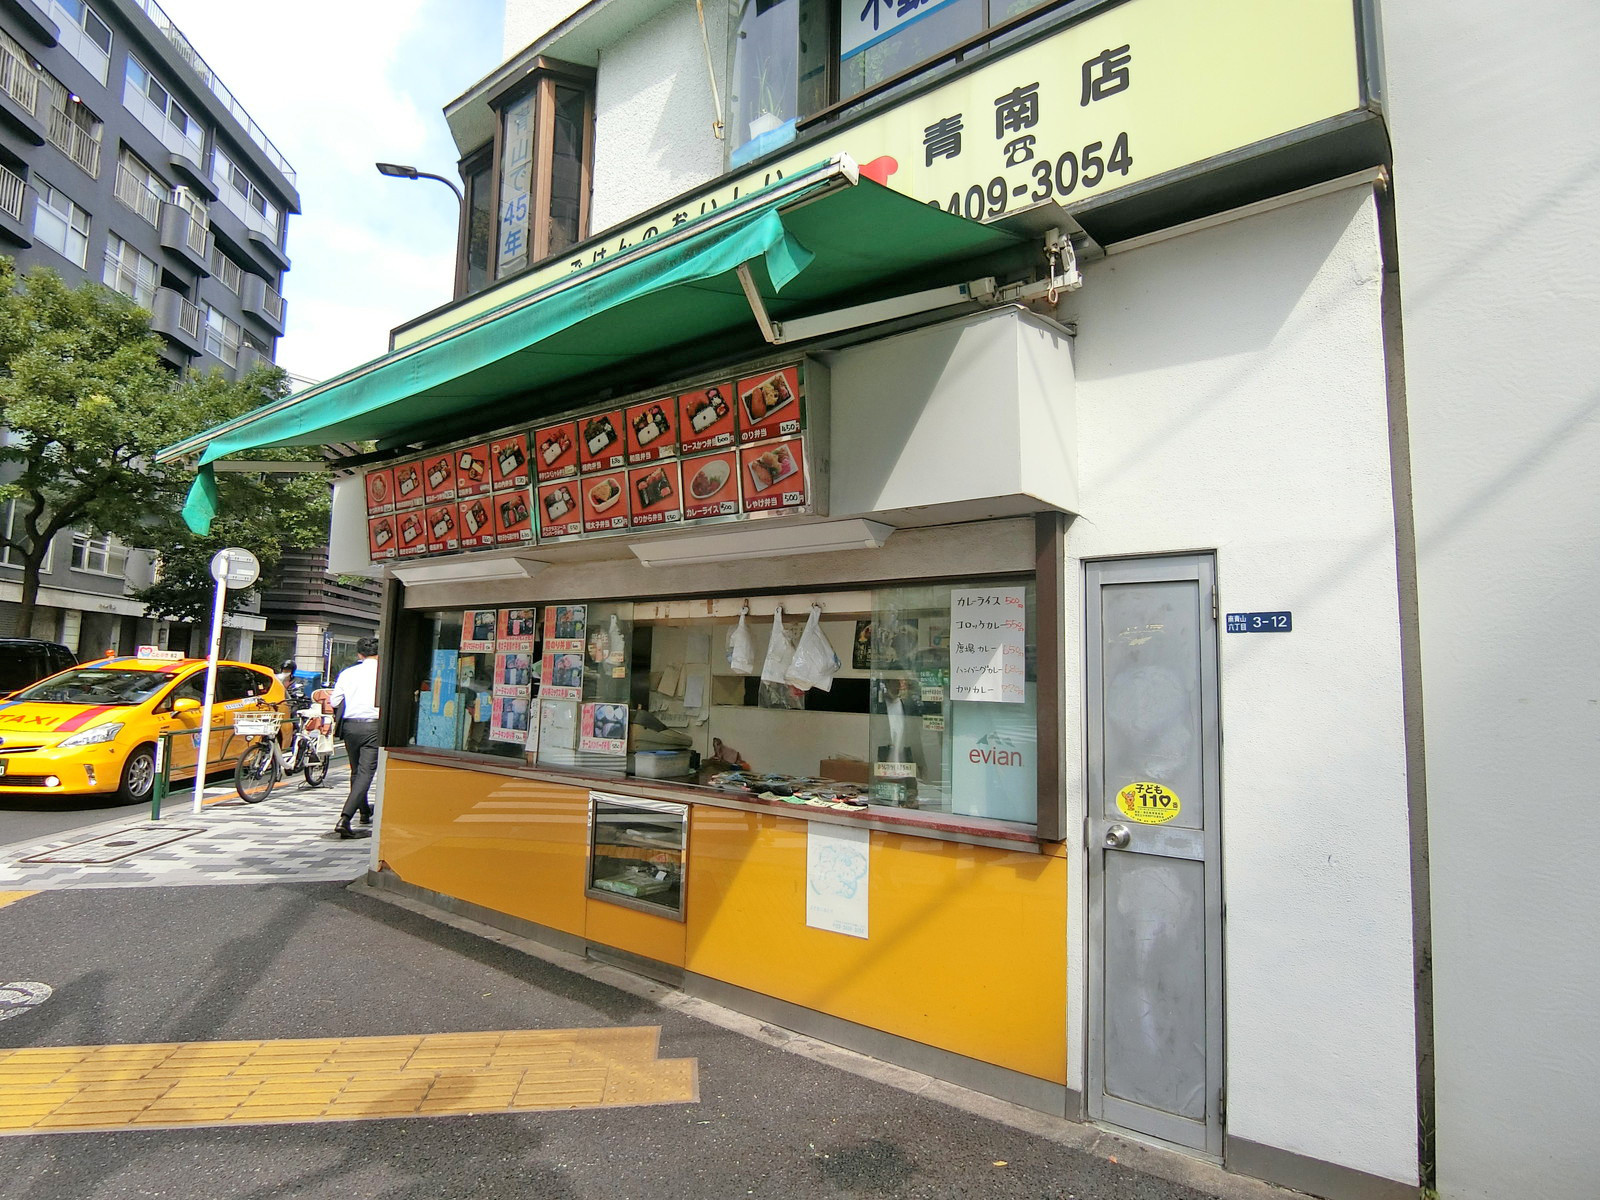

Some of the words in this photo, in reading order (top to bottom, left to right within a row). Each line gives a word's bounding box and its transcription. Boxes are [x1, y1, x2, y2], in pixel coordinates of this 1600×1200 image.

[923, 44, 1131, 167] 青南店
[927, 131, 1133, 222] 409-3054
[742, 428, 767, 440] のり弁当
[745, 498, 777, 509] しゃけ弁当
[687, 505, 719, 517] カレーライス
[957, 596, 1001, 607] カレーライス
[955, 620, 1009, 630] コロッケカレー
[1252, 615, 1288, 628] 3-12
[955, 664, 1003, 675] ハンバーグカレー
[955, 685, 994, 694] カツカレー
[969, 747, 1022, 767] evian
[1135, 783, 1163, 794] 子ども
